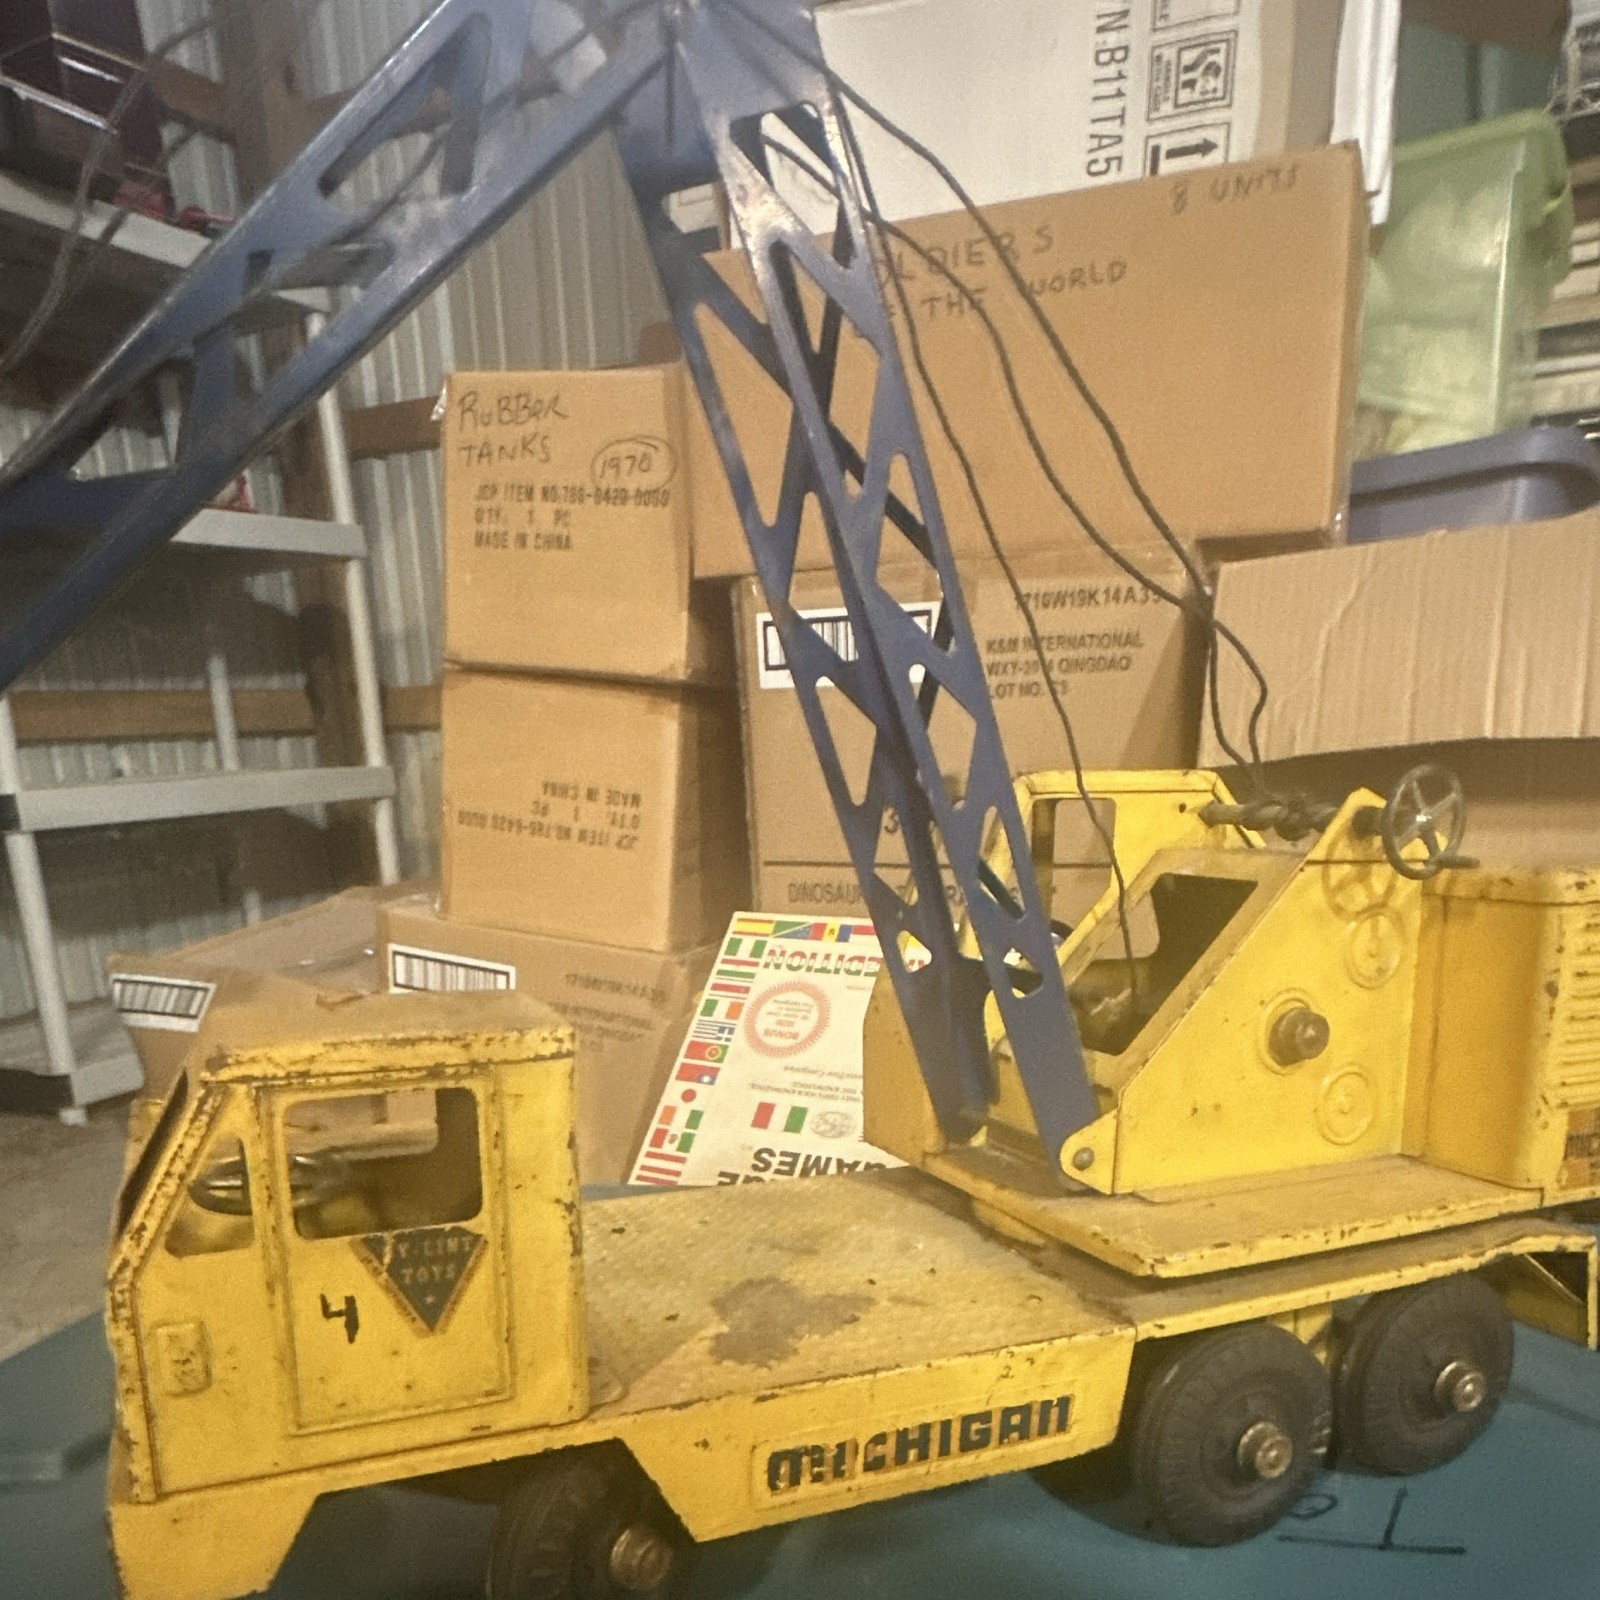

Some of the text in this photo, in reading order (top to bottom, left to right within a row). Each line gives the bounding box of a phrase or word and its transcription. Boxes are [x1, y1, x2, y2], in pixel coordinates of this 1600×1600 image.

[459, 431, 551, 468] TANKS
[475, 531, 572, 550] MADE IN CHINA
[990, 682, 1016, 700] OT
[787, 879, 867, 904] DINOSAU
[763, 949, 884, 977] EDITION
[401, 1263, 456, 1285] TOYS
[319, 1292, 360, 1345] 4
[767, 1393, 1076, 1495] MICHIGAN
